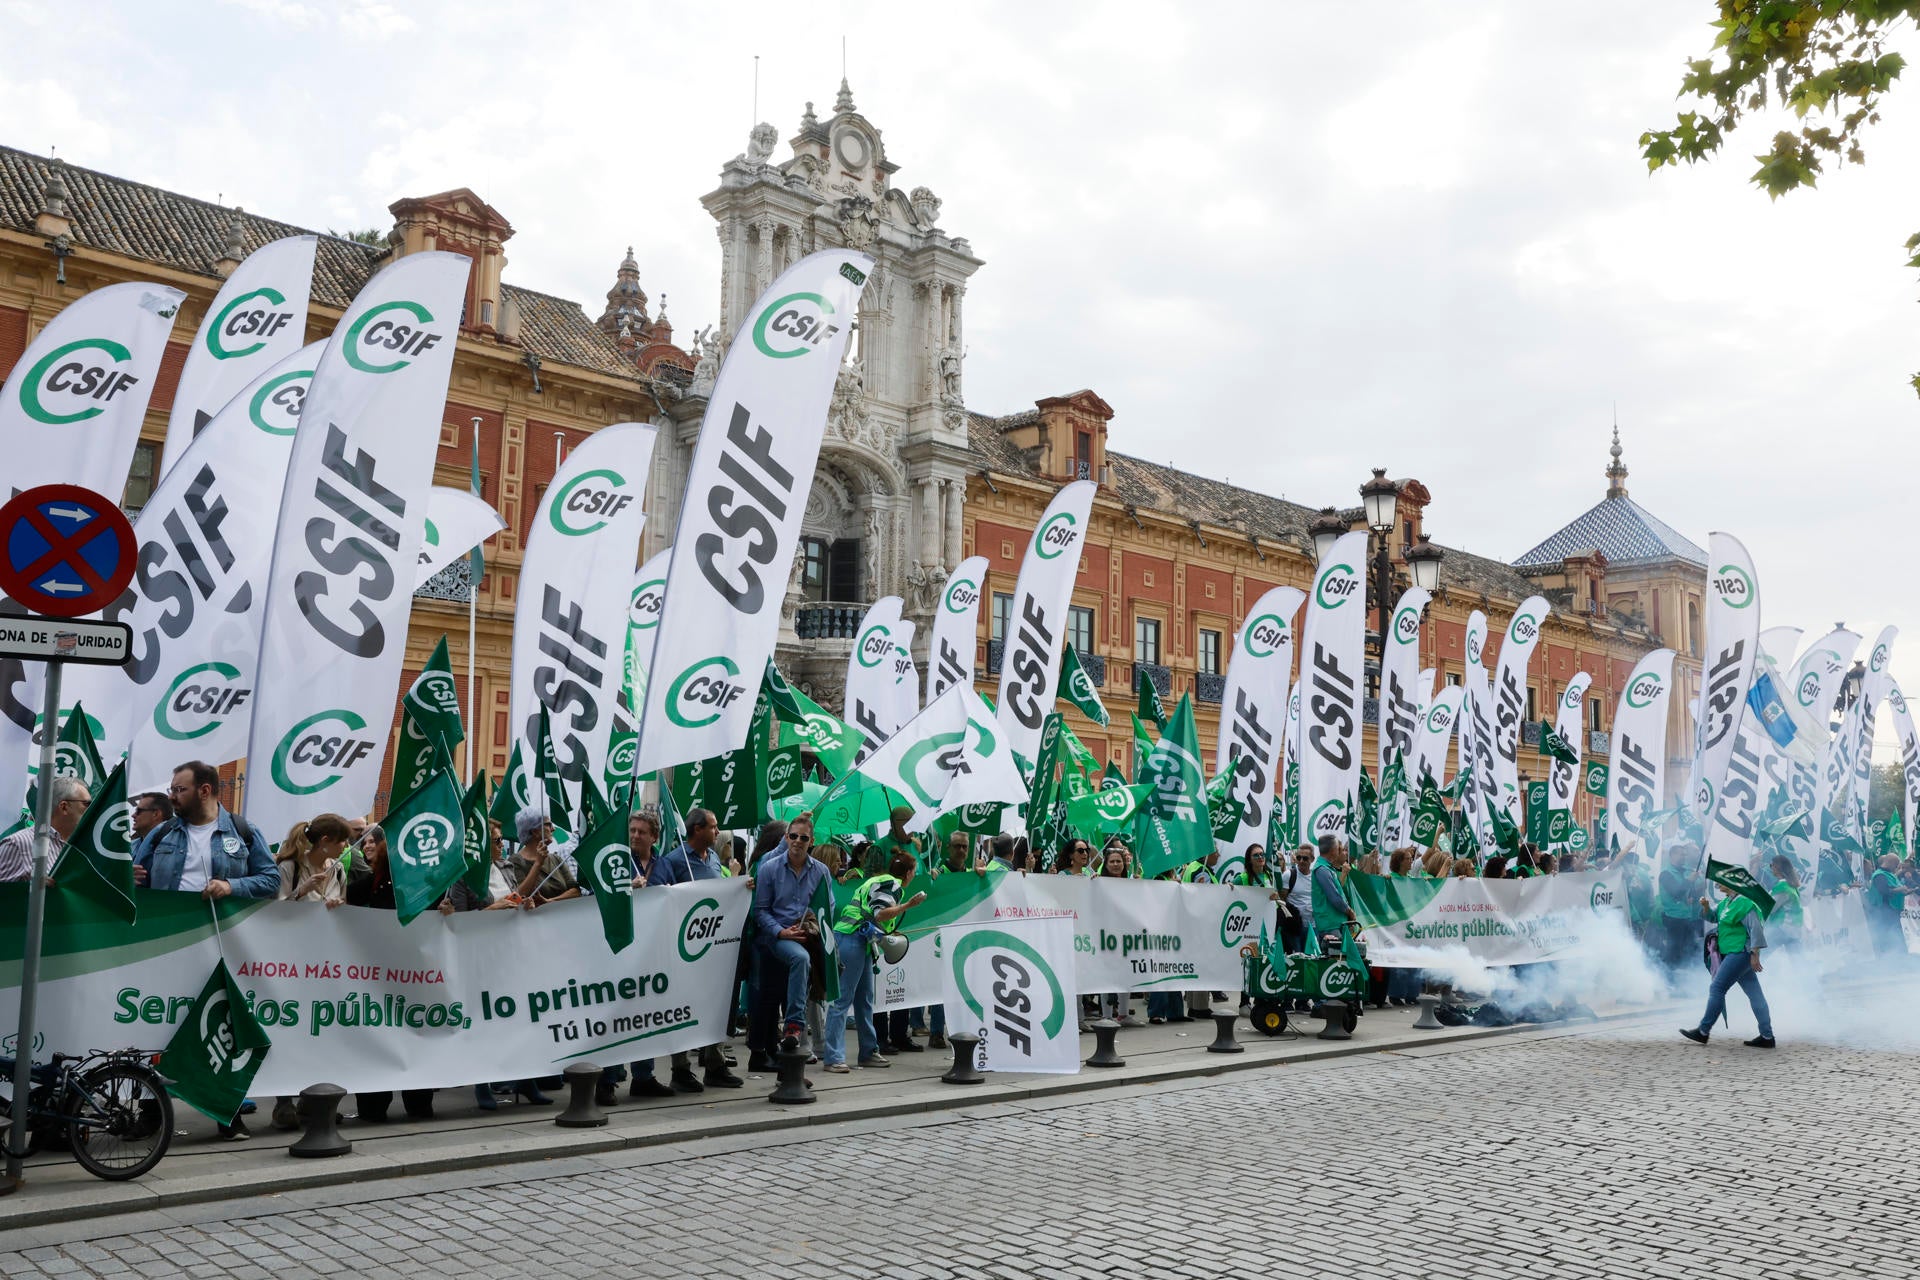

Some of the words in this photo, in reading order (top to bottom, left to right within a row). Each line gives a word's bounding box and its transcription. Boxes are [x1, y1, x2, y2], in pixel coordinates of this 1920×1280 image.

[224, 309, 293, 338] CSIF
[772, 310, 839, 345] CSIF
[363, 320, 442, 357] CSIF
[46, 362, 139, 401] CSIF
[272, 385, 303, 416] CS
[567, 488, 634, 517] CSIF
[695, 401, 794, 614] CSIF
[295, 422, 406, 658] CSIF
[1045, 525, 1077, 546] CSIF
[103, 462, 236, 685] CSIF
[1325, 577, 1358, 596] CSIF
[635, 593, 662, 612] CS
[952, 588, 978, 605] CSIF
[31, 632, 48, 643] DE
[54, 634, 122, 649] URIDAD
[1253, 625, 1290, 648] CSIF
[1517, 621, 1536, 639] CSIF
[865, 637, 894, 655] CSIF
[895, 659, 911, 675] SIF
[1007, 592, 1053, 729] CSIF
[527, 583, 607, 782] CSIF
[684, 677, 746, 709] CSIF
[1634, 682, 1663, 698] CSIF
[173, 685, 251, 715] CSIF
[427, 680, 460, 715] CSIF
[1309, 642, 1353, 770] CSIF
[806, 721, 843, 751] CSIF
[292, 734, 376, 769] CSIF
[615, 749, 636, 763] CS
[1226, 686, 1272, 827] CSIF
[410, 746, 433, 789] CS
[770, 763, 796, 781] CSIF
[686, 760, 703, 816] SIF
[1148, 754, 1197, 823] CSIF
[1533, 791, 1546, 799] CSIF
[1715, 733, 1759, 839] CSIF
[969, 801, 997, 816] CSIF
[1507, 795, 1517, 807] IF
[1150, 807, 1172, 855] Córdoba
[1209, 810, 1236, 825] CSIF
[1316, 813, 1347, 830] CSIF
[1419, 820, 1435, 832] CSIF
[1552, 821, 1567, 831] CSIF
[413, 824, 440, 867] CSIF
[1386, 826, 1400, 840] CS
[995, 907, 1024, 918] AHORA
[1457, 902, 1470, 912] MÁS
[1472, 904, 1483, 912] QUE
[1595, 892, 1613, 906] CSIF
[687, 916, 723, 941] CSIF
[1226, 915, 1251, 932] CSIF
[1405, 920, 1458, 939] Servicios
[1100, 929, 1118, 952] lo
[1122, 929, 1181, 956] primero
[238, 961, 299, 978] AHORA
[305, 960, 341, 980] MÁS
[347, 964, 380, 981] QUE
[386, 968, 445, 984] NUNCA
[1131, 959, 1146, 973] Tú
[1158, 960, 1194, 974] mereces
[310, 992, 472, 1036] públicos,
[481, 991, 516, 1020] lo
[528, 972, 669, 1023] primero
[991, 954, 1031, 1057] CSIF
[548, 1021, 578, 1042] Tú
[586, 1018, 606, 1037] lo
[613, 1005, 691, 1033] mereces
[977, 1027, 989, 1069] Córdo
